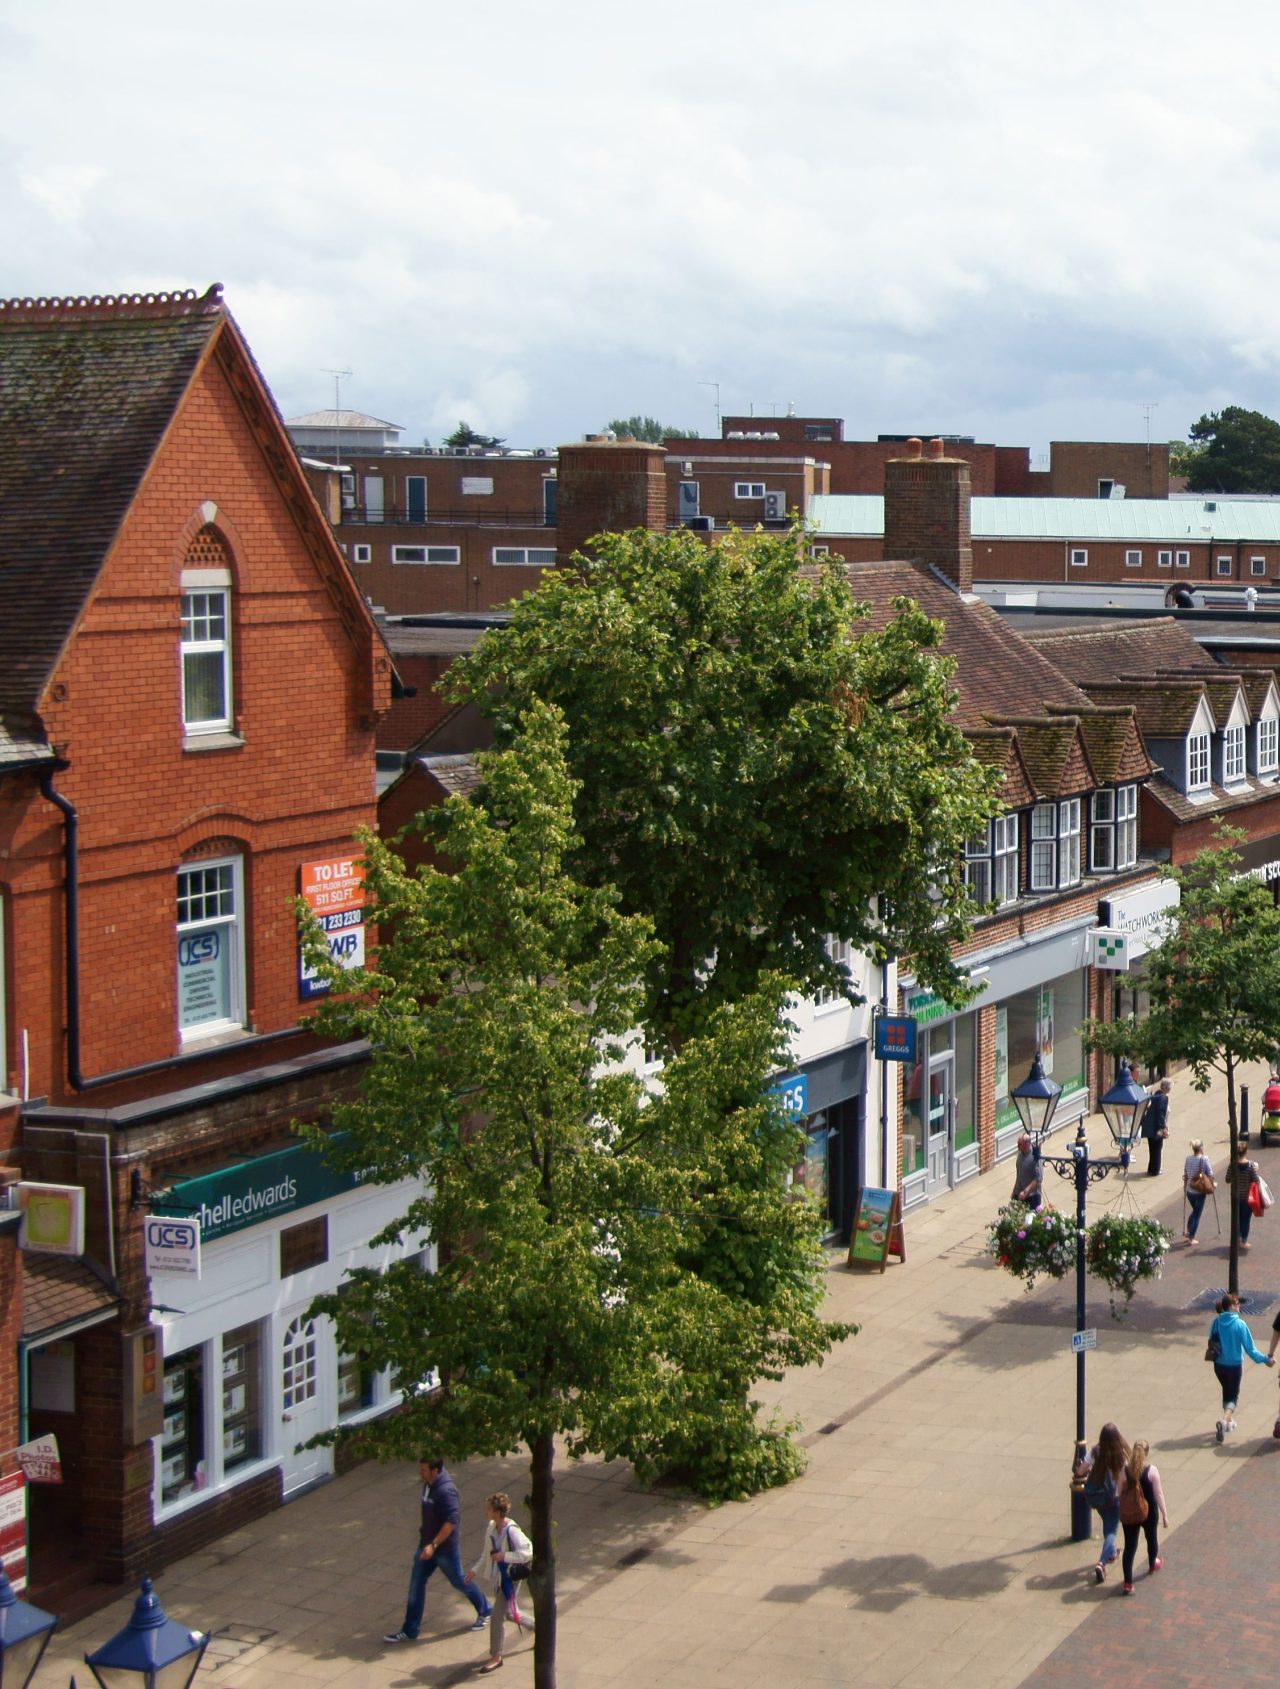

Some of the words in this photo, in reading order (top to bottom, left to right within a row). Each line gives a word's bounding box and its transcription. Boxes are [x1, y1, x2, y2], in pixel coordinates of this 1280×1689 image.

[313, 864, 332, 881] TO
[333, 861, 354, 877] LET
[322, 880, 341, 891] FLOOR
[316, 893, 330, 906] 511
[328, 913, 343, 930] 233
[343, 909, 361, 926] 2330
[1117, 910, 1126, 921] The
[179, 931, 220, 967] JCS
[883, 1044, 910, 1054] GREGGS
[232, 1175, 297, 1217] edwards
[149, 1223, 195, 1250] JCS
[37, 1444, 56, 1454] I.D.
[20, 1450, 57, 1463] Photos
